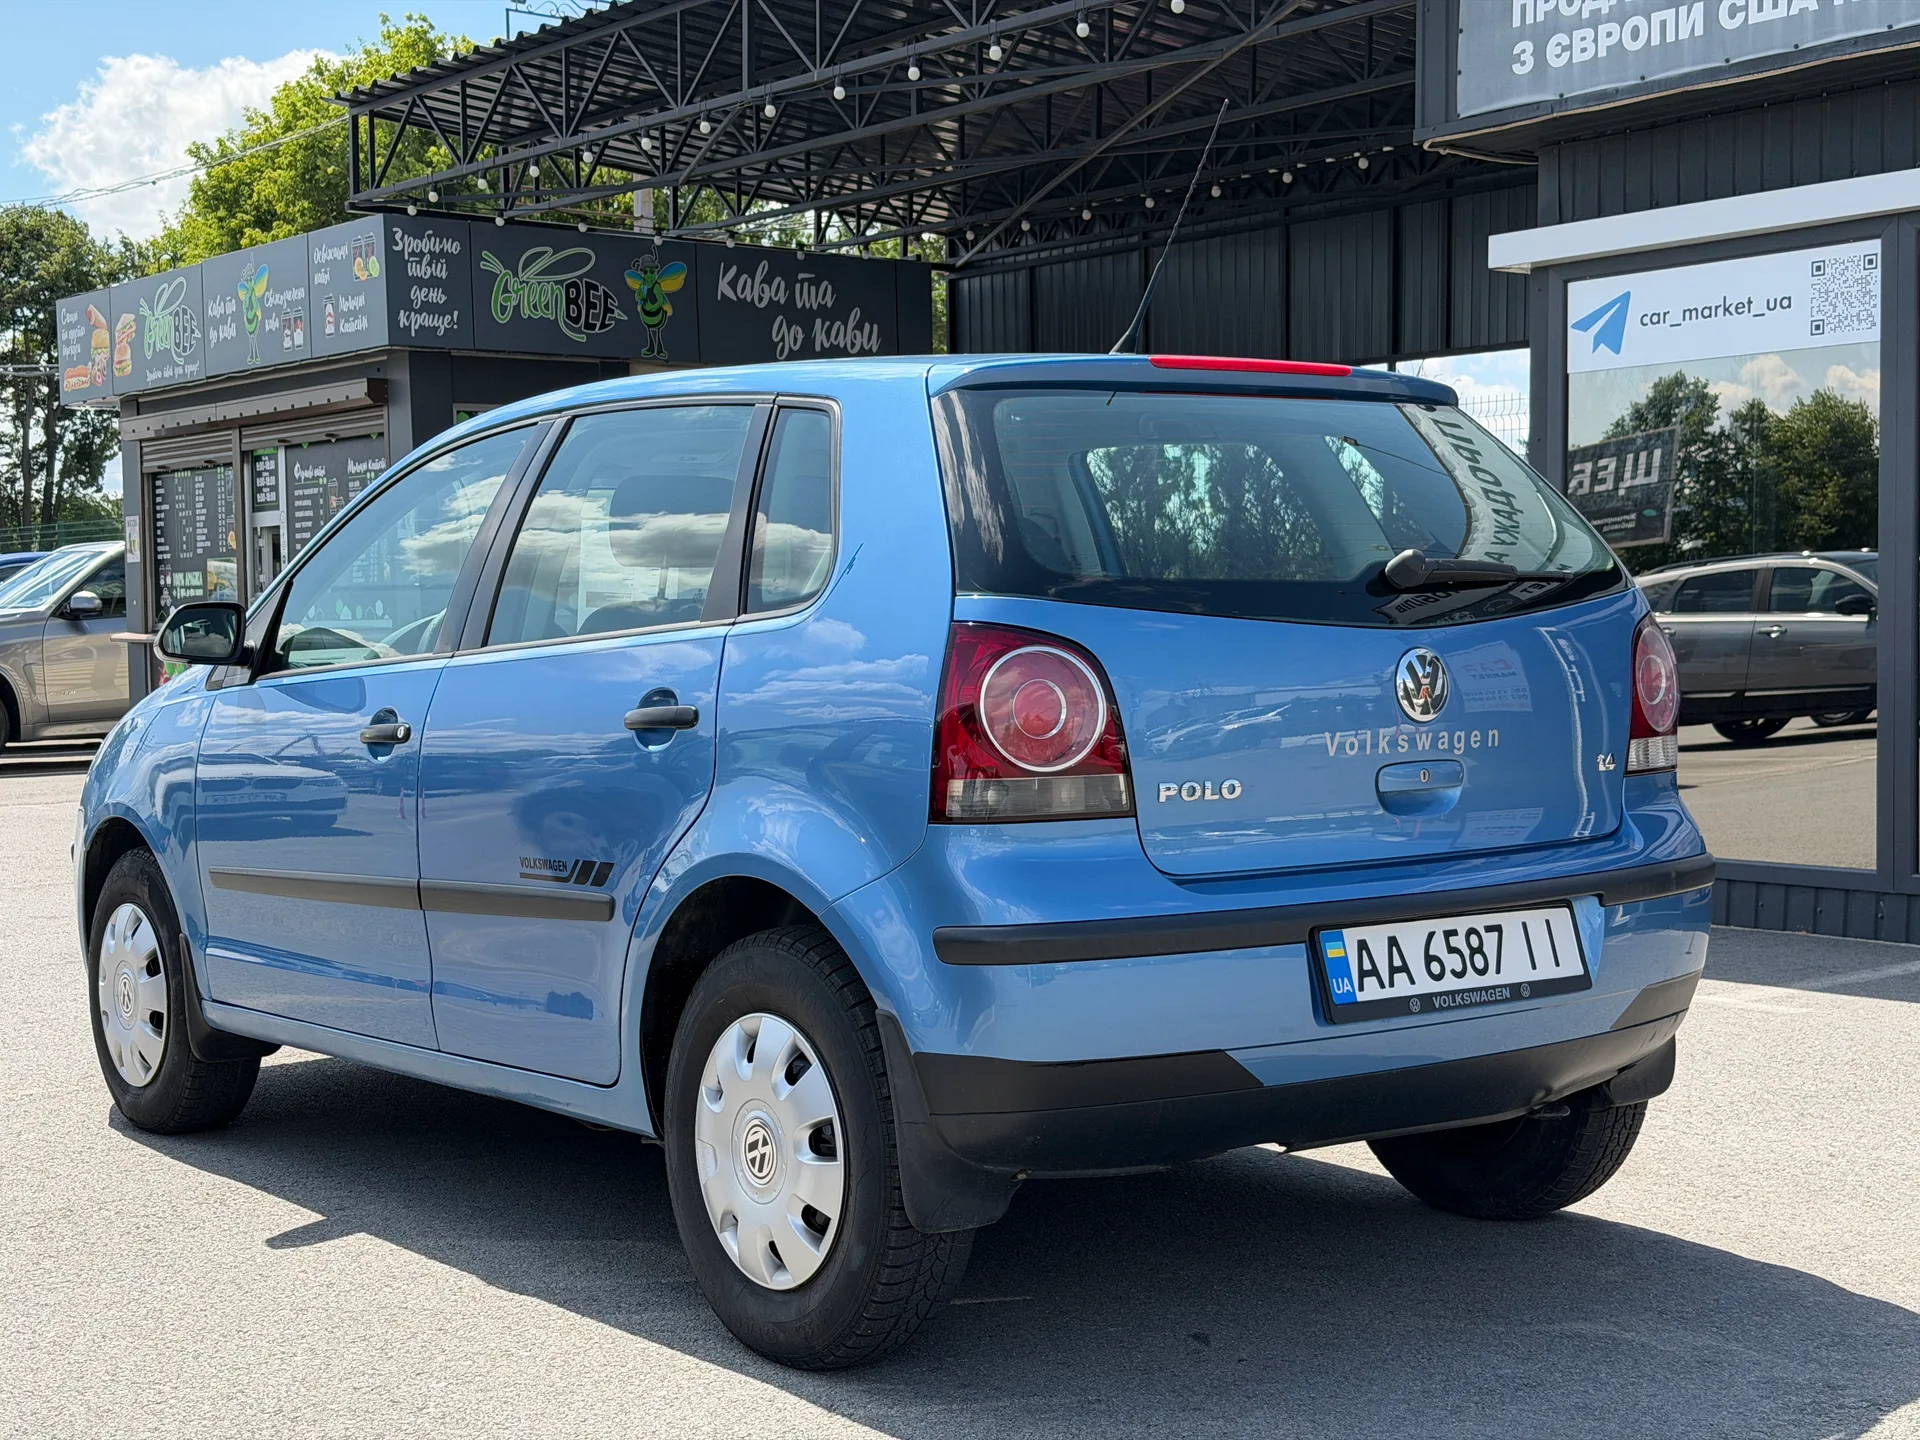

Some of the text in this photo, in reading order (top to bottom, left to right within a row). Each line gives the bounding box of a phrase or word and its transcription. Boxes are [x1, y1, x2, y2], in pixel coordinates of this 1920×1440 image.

[1511, 40, 1535, 75] З
[1545, 0, 1704, 68] ЄВРОПИ
[391, 227, 461, 265] Зробимо
[407, 252, 449, 282] твій
[409, 285, 447, 312] день
[717, 261, 836, 310] Кава та
[397, 308, 459, 338] краще!
[1639, 295, 1793, 328] car_market_ua
[771, 308, 882, 360] до кави
[1324, 728, 1500, 757] Volkswagen
[1157, 778, 1243, 804] POLO
[519, 855, 568, 873] VOLKSWAGEN
[1356, 935, 1417, 993] AA
[1423, 923, 1504, 982] 6587
[1332, 976, 1354, 995] UA
[1431, 986, 1511, 1009] VOLKSWAGEN
